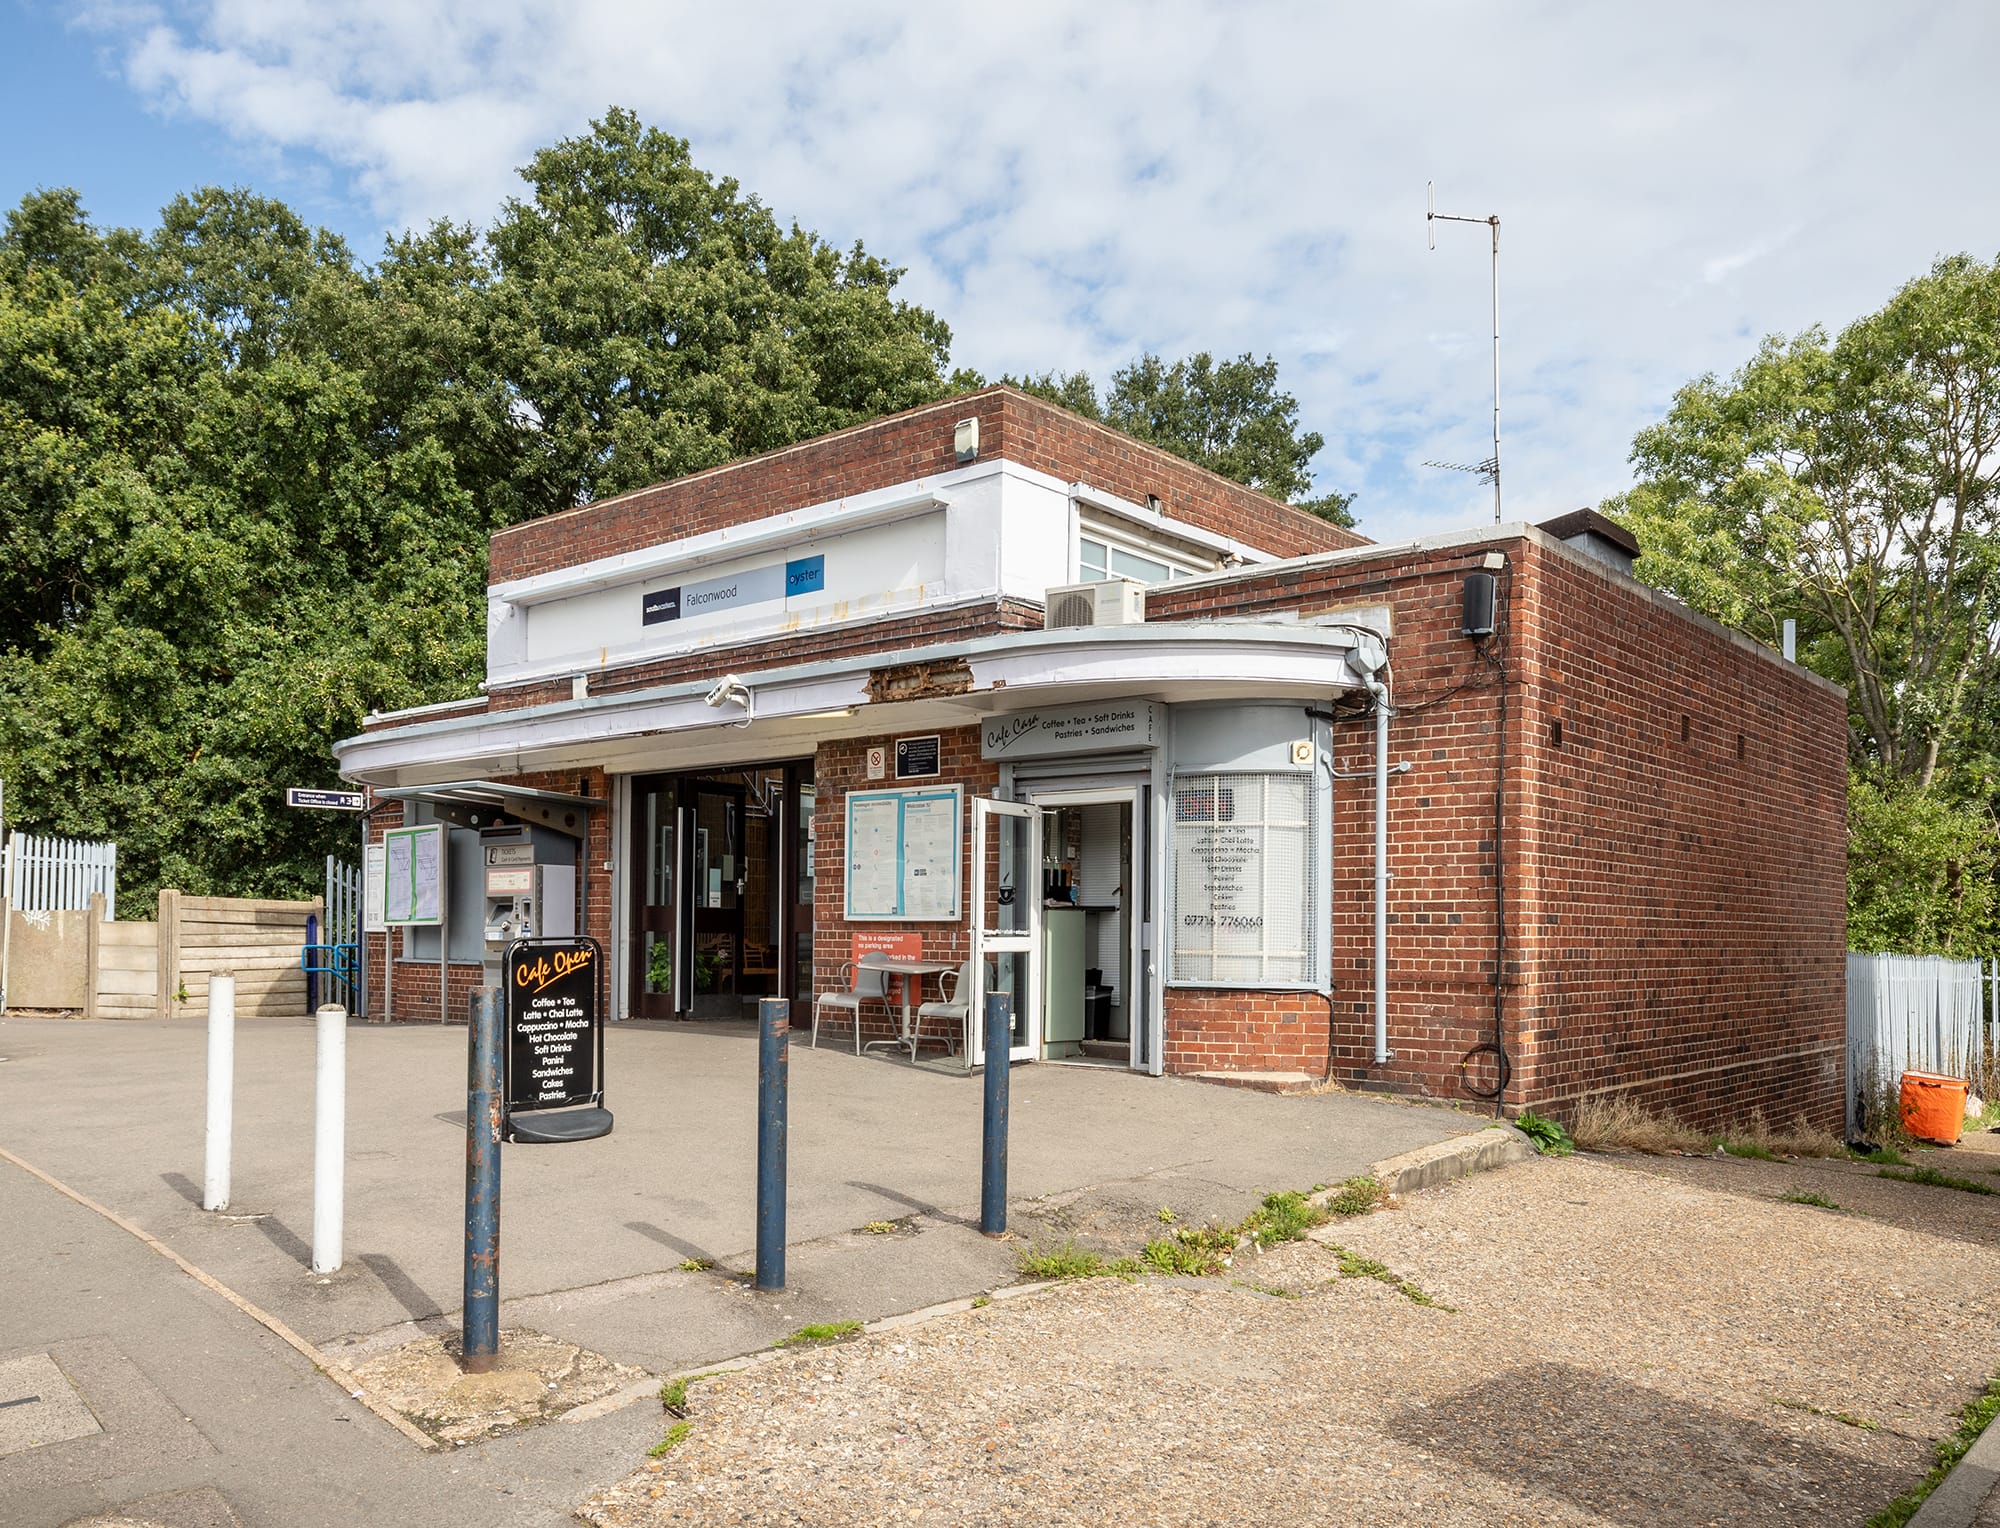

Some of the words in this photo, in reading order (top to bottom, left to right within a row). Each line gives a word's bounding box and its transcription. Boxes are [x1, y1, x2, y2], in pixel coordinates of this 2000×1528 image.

[789, 569, 819, 586] oyster
[686, 585, 737, 607] Falconwood
[1042, 720, 1064, 729] Coffee
[1073, 717, 1086, 725] Tea
[1094, 713, 1109, 723] Soft
[1111, 710, 1135, 720] Drinks
[988, 725, 1010, 748] Cafe
[1055, 729, 1082, 739] Pastries
[1091, 723, 1135, 735] Sandwiches
[517, 956, 551, 987] Cafe
[554, 950, 592, 974] Open
[532, 998, 555, 1008] Coffee
[562, 997, 576, 1006] Tea
[523, 1011, 542, 1020] Latte
[549, 1009, 565, 1018] Chai
[566, 1008, 584, 1017] Latte
[517, 1021, 558, 1034] Cappuccino
[565, 1019, 589, 1029] Mocha
[529, 1034, 542, 1043] Hot
[543, 1031, 578, 1042] Chocolate
[534, 1045, 549, 1055] Soft
[550, 1043, 572, 1053] Drinks
[542, 1055, 564, 1066] Panini
[532, 1066, 574, 1078] Sandwiches
[542, 1079, 563, 1089] Cakes
[539, 1090, 566, 1101] Pastries
